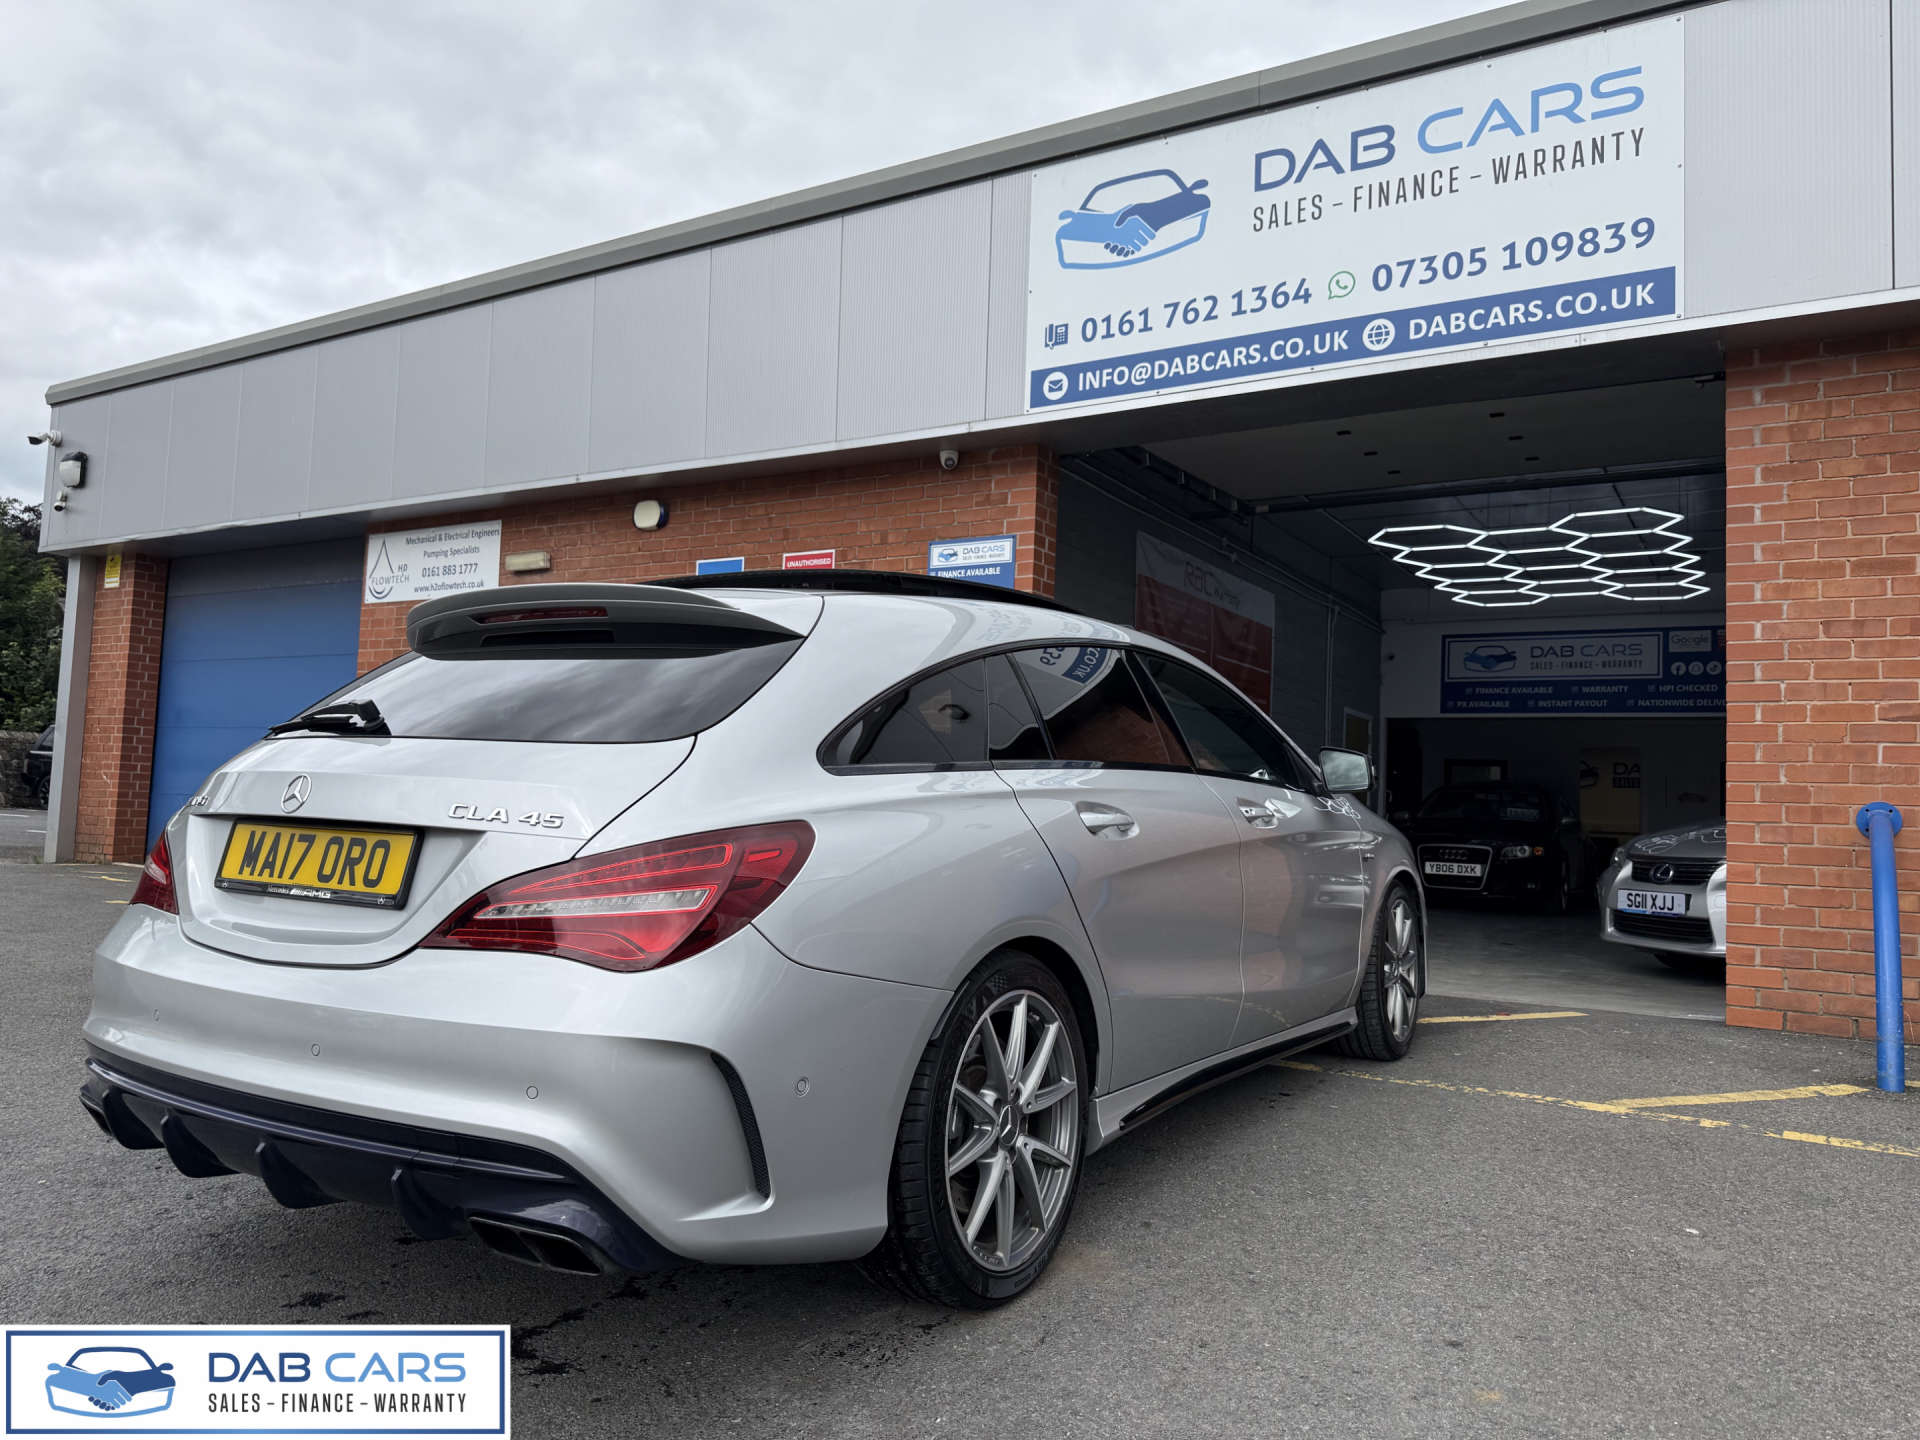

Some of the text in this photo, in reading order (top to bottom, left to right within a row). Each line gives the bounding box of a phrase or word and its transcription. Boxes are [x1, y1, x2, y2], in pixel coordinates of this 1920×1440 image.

[1252, 65, 1645, 193] DAB CARS
[1252, 194, 1323, 233] SALES
[1353, 165, 1460, 214] FINANCE
[1491, 127, 1646, 186] WARRANTY
[1080, 216, 1656, 344] 0161 762 1364 07305 109839
[1077, 281, 1656, 392] INFO@DABCARS.CO.UK DABCARS.CO.UK
[406, 527, 500, 546] Mechanical & Electrical Engineers
[423, 545, 480, 560] Pumping Specialists
[962, 544, 1005, 555] DAB CARS
[422, 562, 479, 579] 0161 883 1777
[937, 566, 1001, 578] FINANCE AVAILABLE
[371, 575, 410, 586] FLOWTECH
[1530, 643, 1643, 659] DAB CARS
[1676, 683, 1718, 693] CHECKED
[447, 803, 565, 830] CLA 45
[238, 829, 392, 888] MA17 ORO
[1626, 892, 1675, 911] SG11 XJJ
